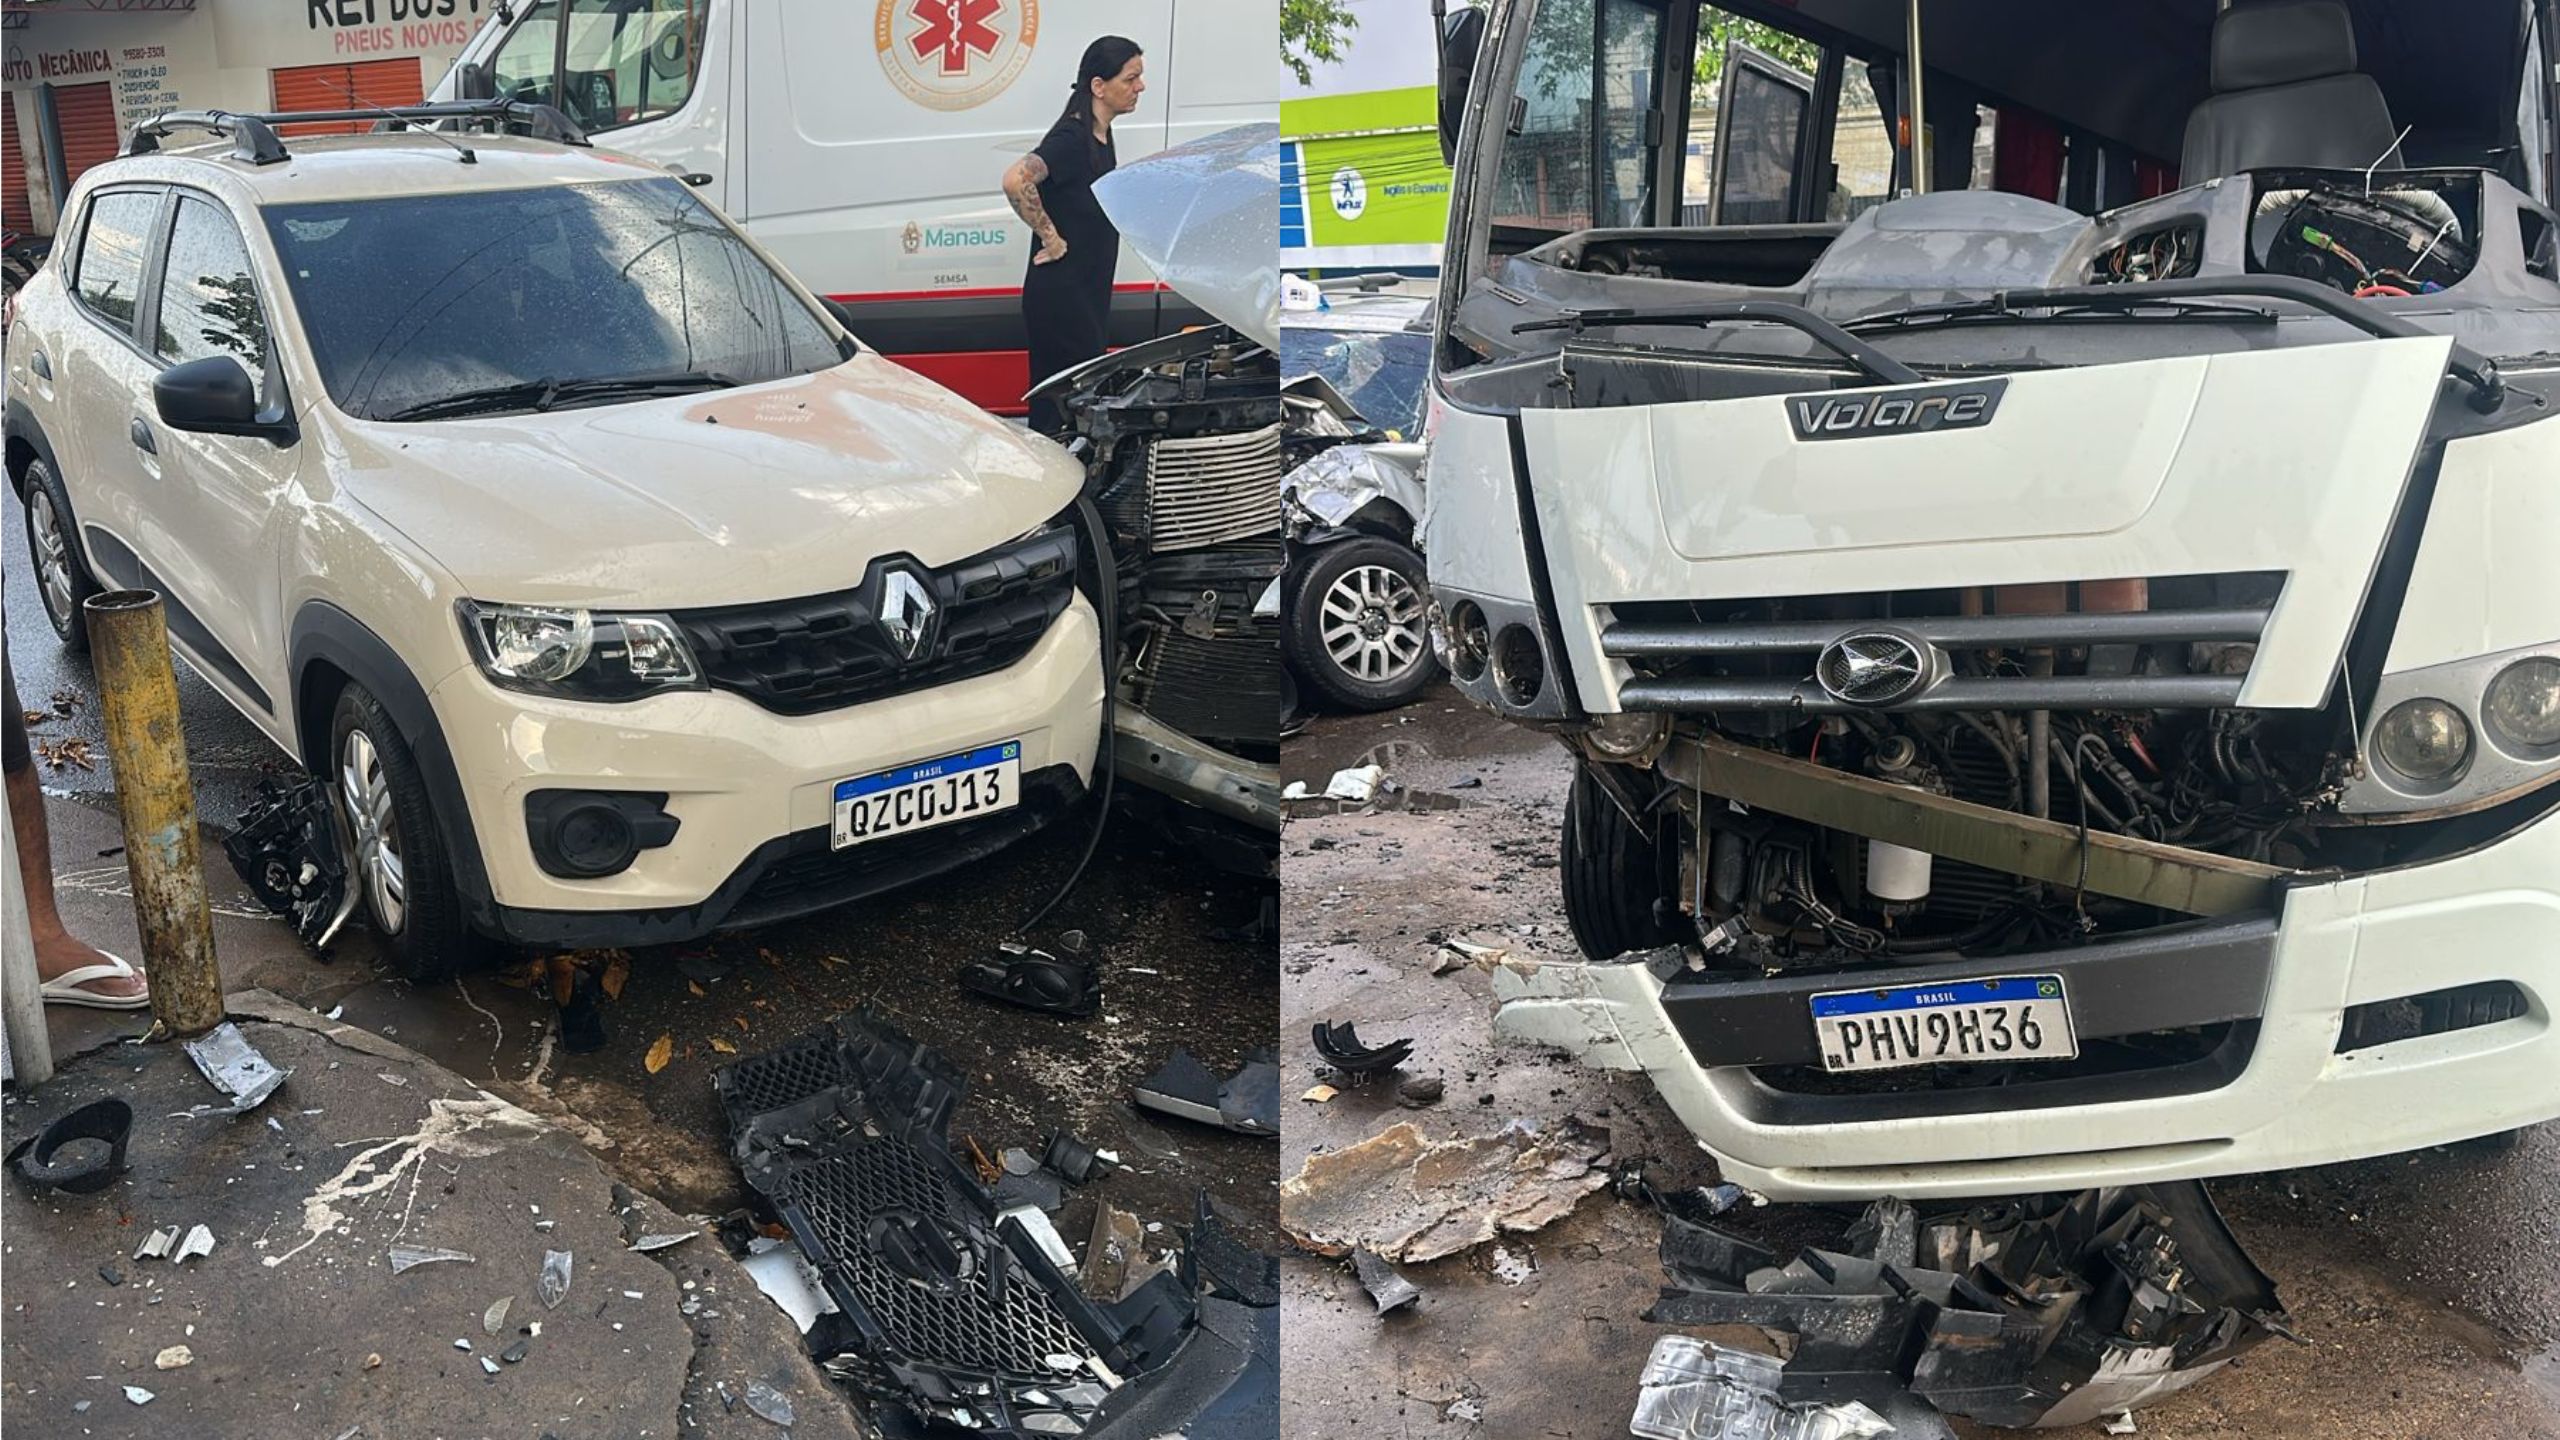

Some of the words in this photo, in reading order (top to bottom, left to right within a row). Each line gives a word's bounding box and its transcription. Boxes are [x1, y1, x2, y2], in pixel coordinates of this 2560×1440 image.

[334, 27, 394, 53] PNEUS
[402, 20, 468, 48] NOVOS
[38, 49, 112, 78] MECÂNICA
[926, 229, 1006, 248] Manaus
[934, 274, 968, 284] SEMSA
[913, 765, 943, 781] BRASIL
[1916, 994, 1956, 1005] BRASIL
[1837, 1005, 2042, 1064] PHV9H36
[1827, 1054, 1845, 1068] BR
